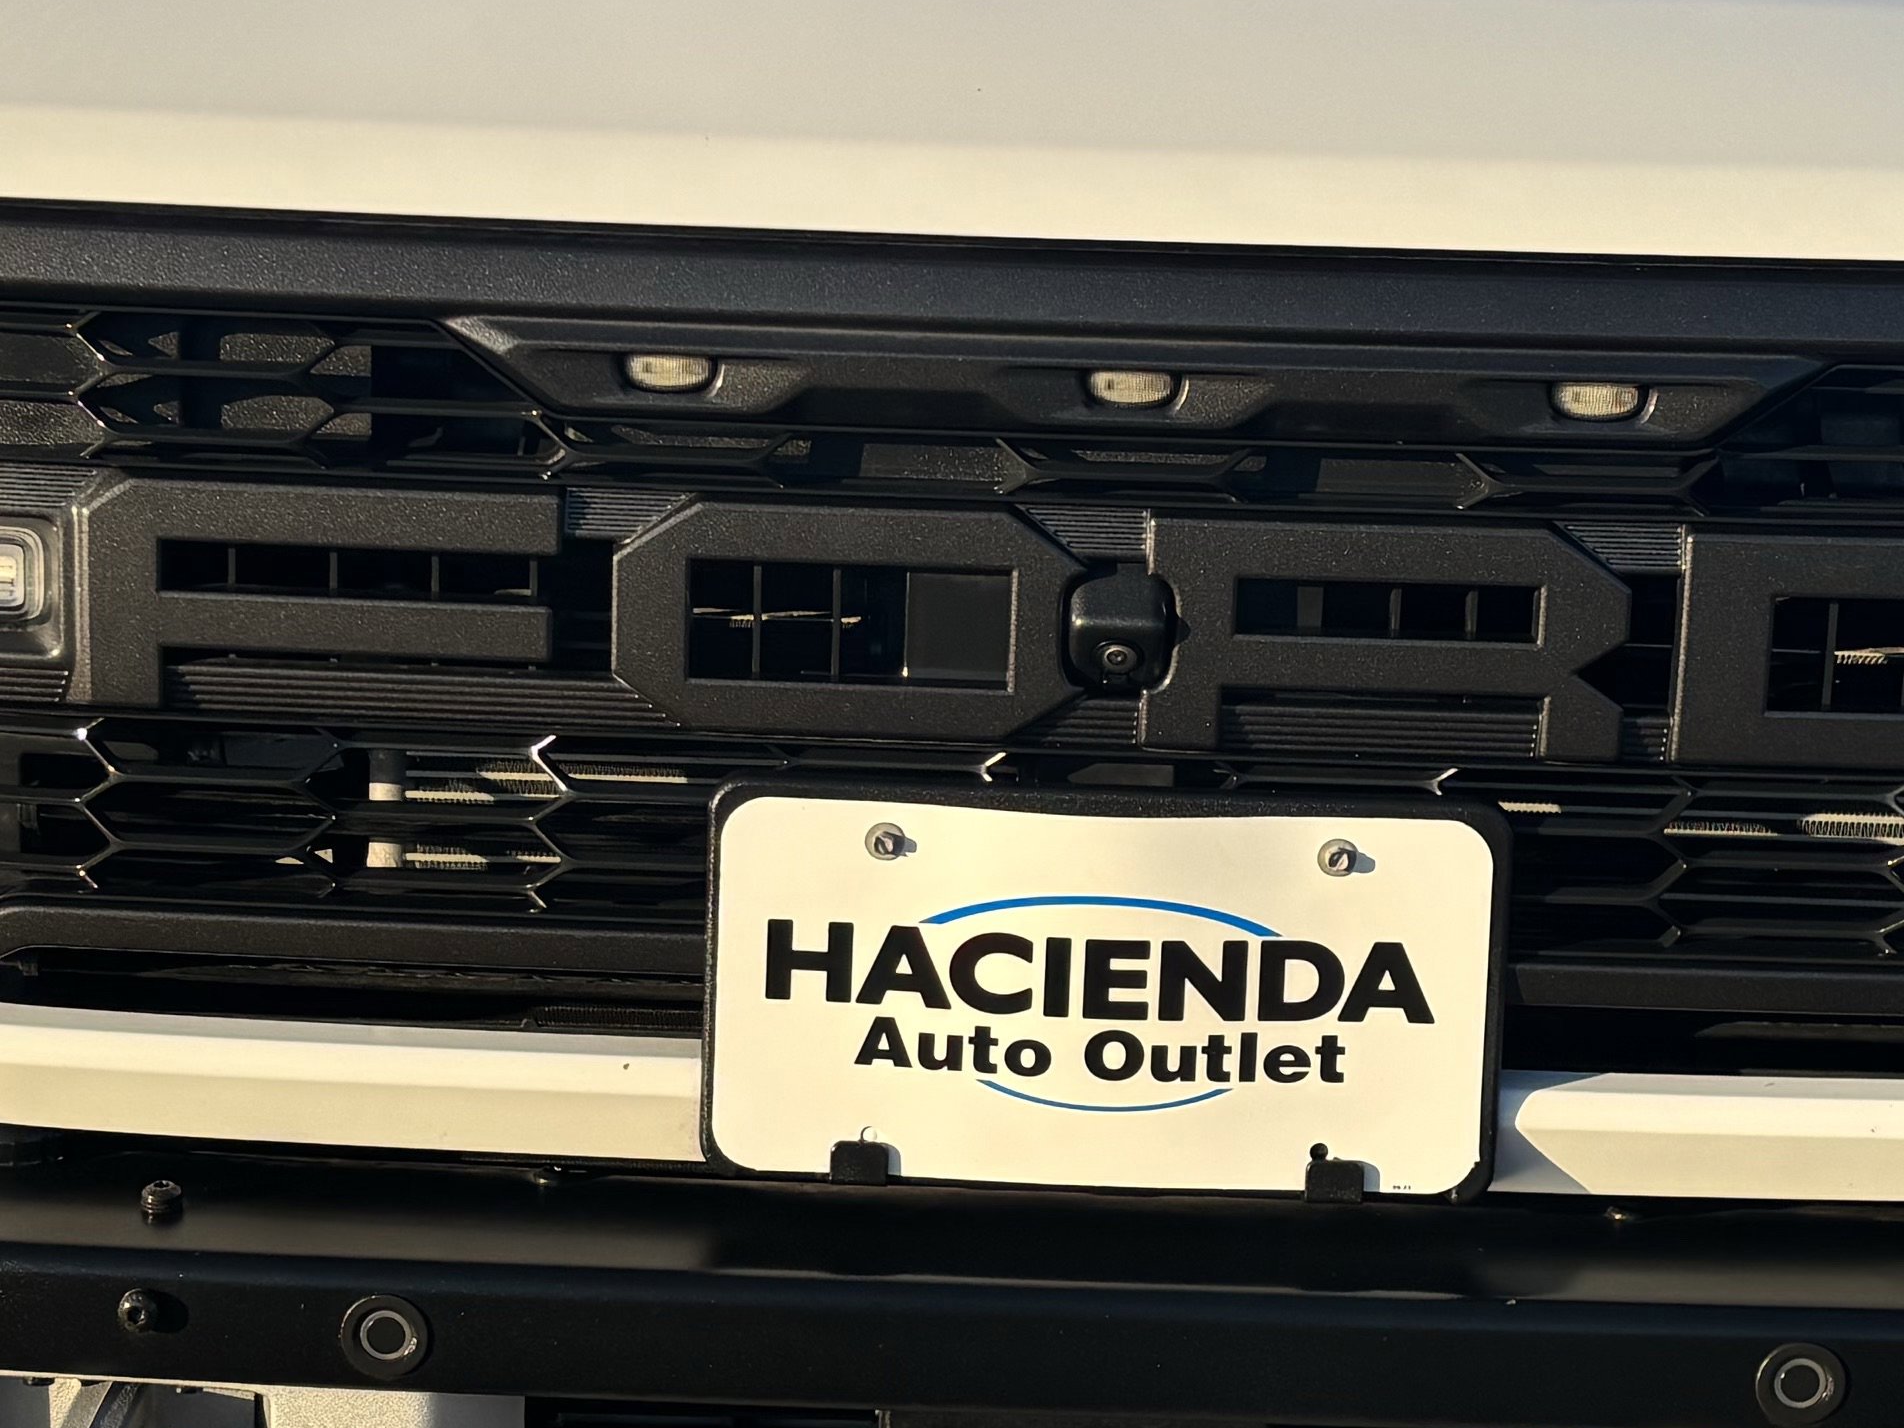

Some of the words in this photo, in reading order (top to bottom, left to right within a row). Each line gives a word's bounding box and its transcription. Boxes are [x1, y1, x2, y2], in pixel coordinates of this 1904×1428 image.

[764, 918, 1436, 1025] HACIENDA
[854, 1016, 1052, 1077] Auto
[1083, 1029, 1347, 1085] Outlet
